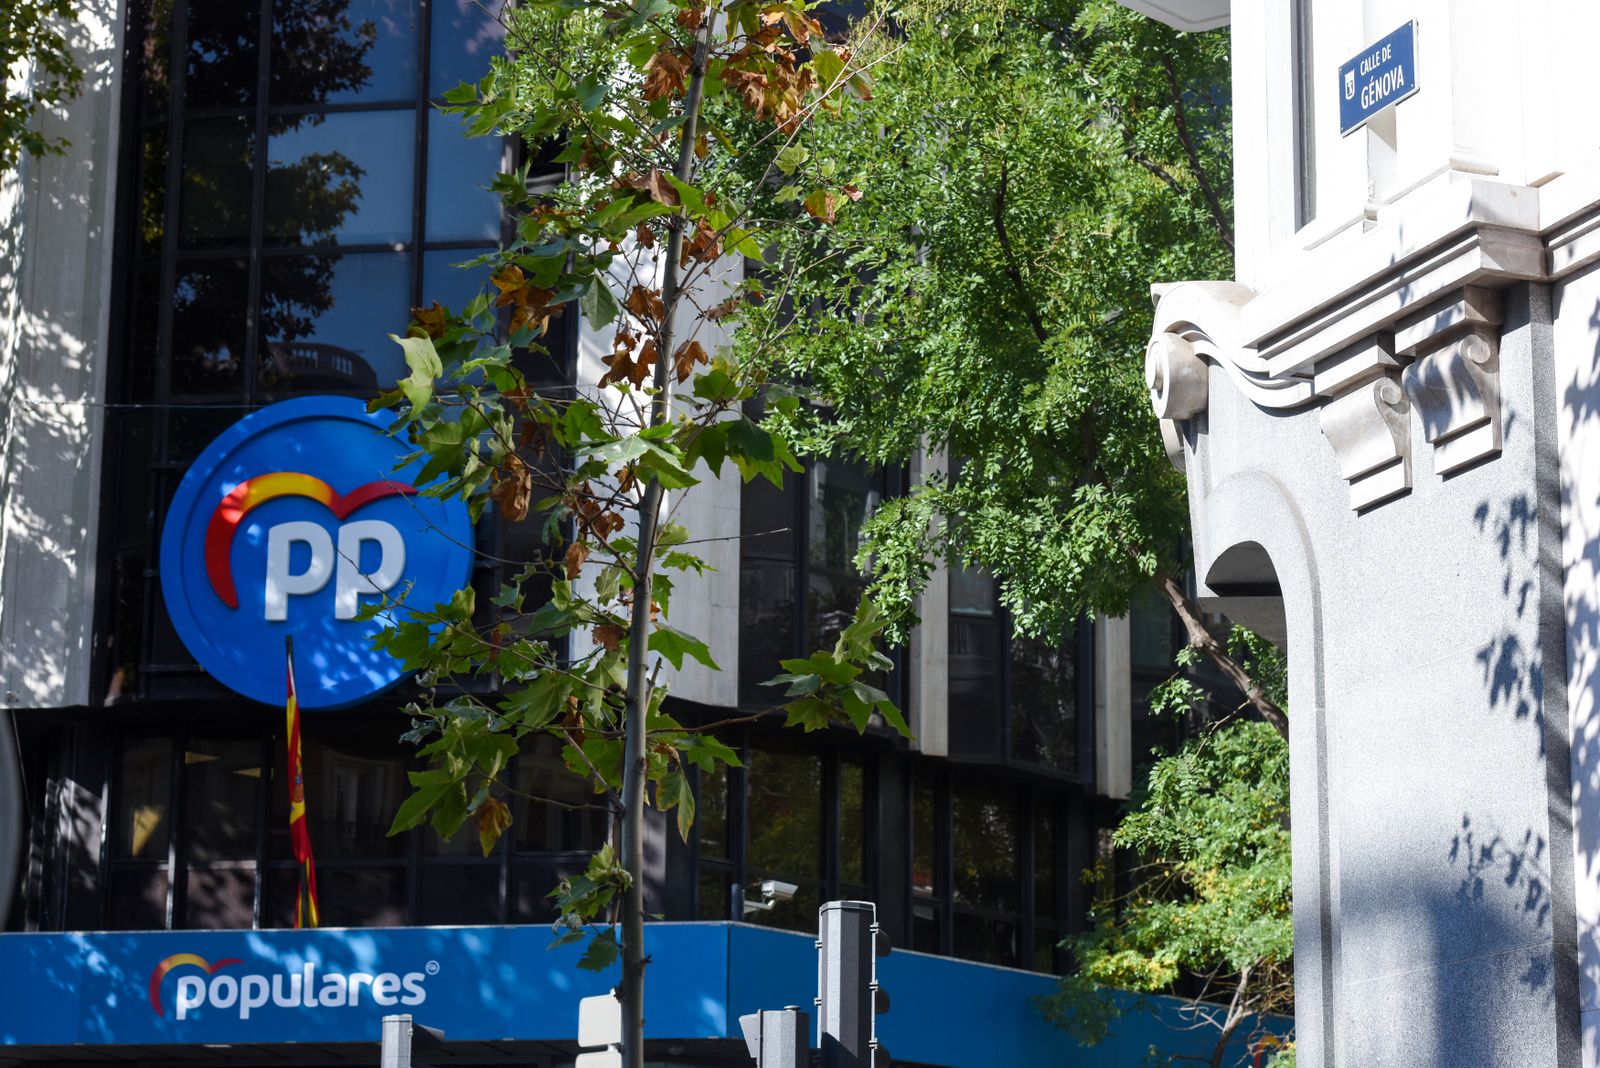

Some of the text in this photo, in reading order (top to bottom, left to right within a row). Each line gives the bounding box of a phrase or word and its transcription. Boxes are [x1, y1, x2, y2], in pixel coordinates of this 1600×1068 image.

[1360, 43, 1392, 76] CALLE DE
[1361, 64, 1404, 110] GÉNOVA
[176, 962, 426, 1020] populares
